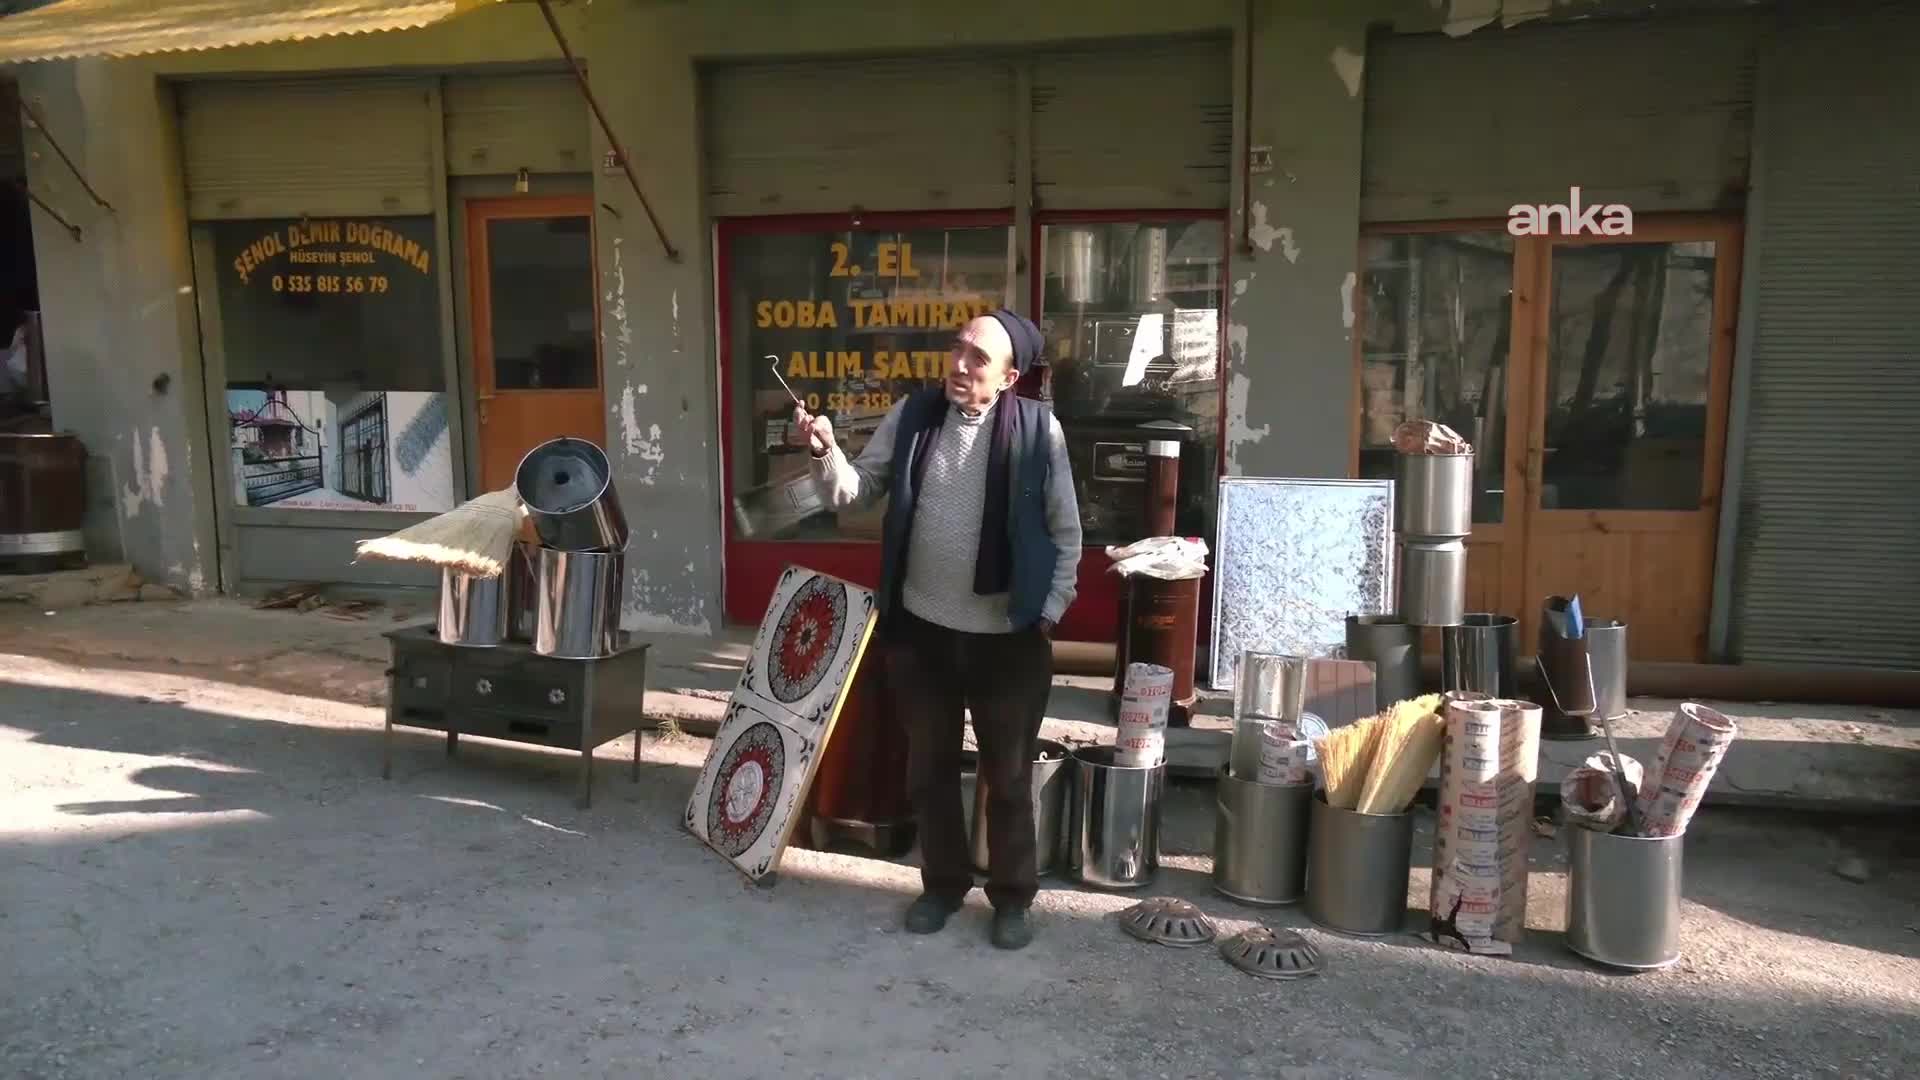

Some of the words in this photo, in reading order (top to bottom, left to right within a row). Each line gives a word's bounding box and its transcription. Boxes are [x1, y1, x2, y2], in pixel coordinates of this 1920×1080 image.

[339, 252, 376, 266] ŞENOL
[830, 242, 862, 277] 2.
[877, 243, 920, 277] EL
[288, 276, 312, 292] 535
[317, 276, 340, 292] 815
[345, 276, 364, 292] 56
[369, 276, 388, 292] 79
[756, 300, 838, 328] SOBA
[788, 351, 862, 379] ALIM
